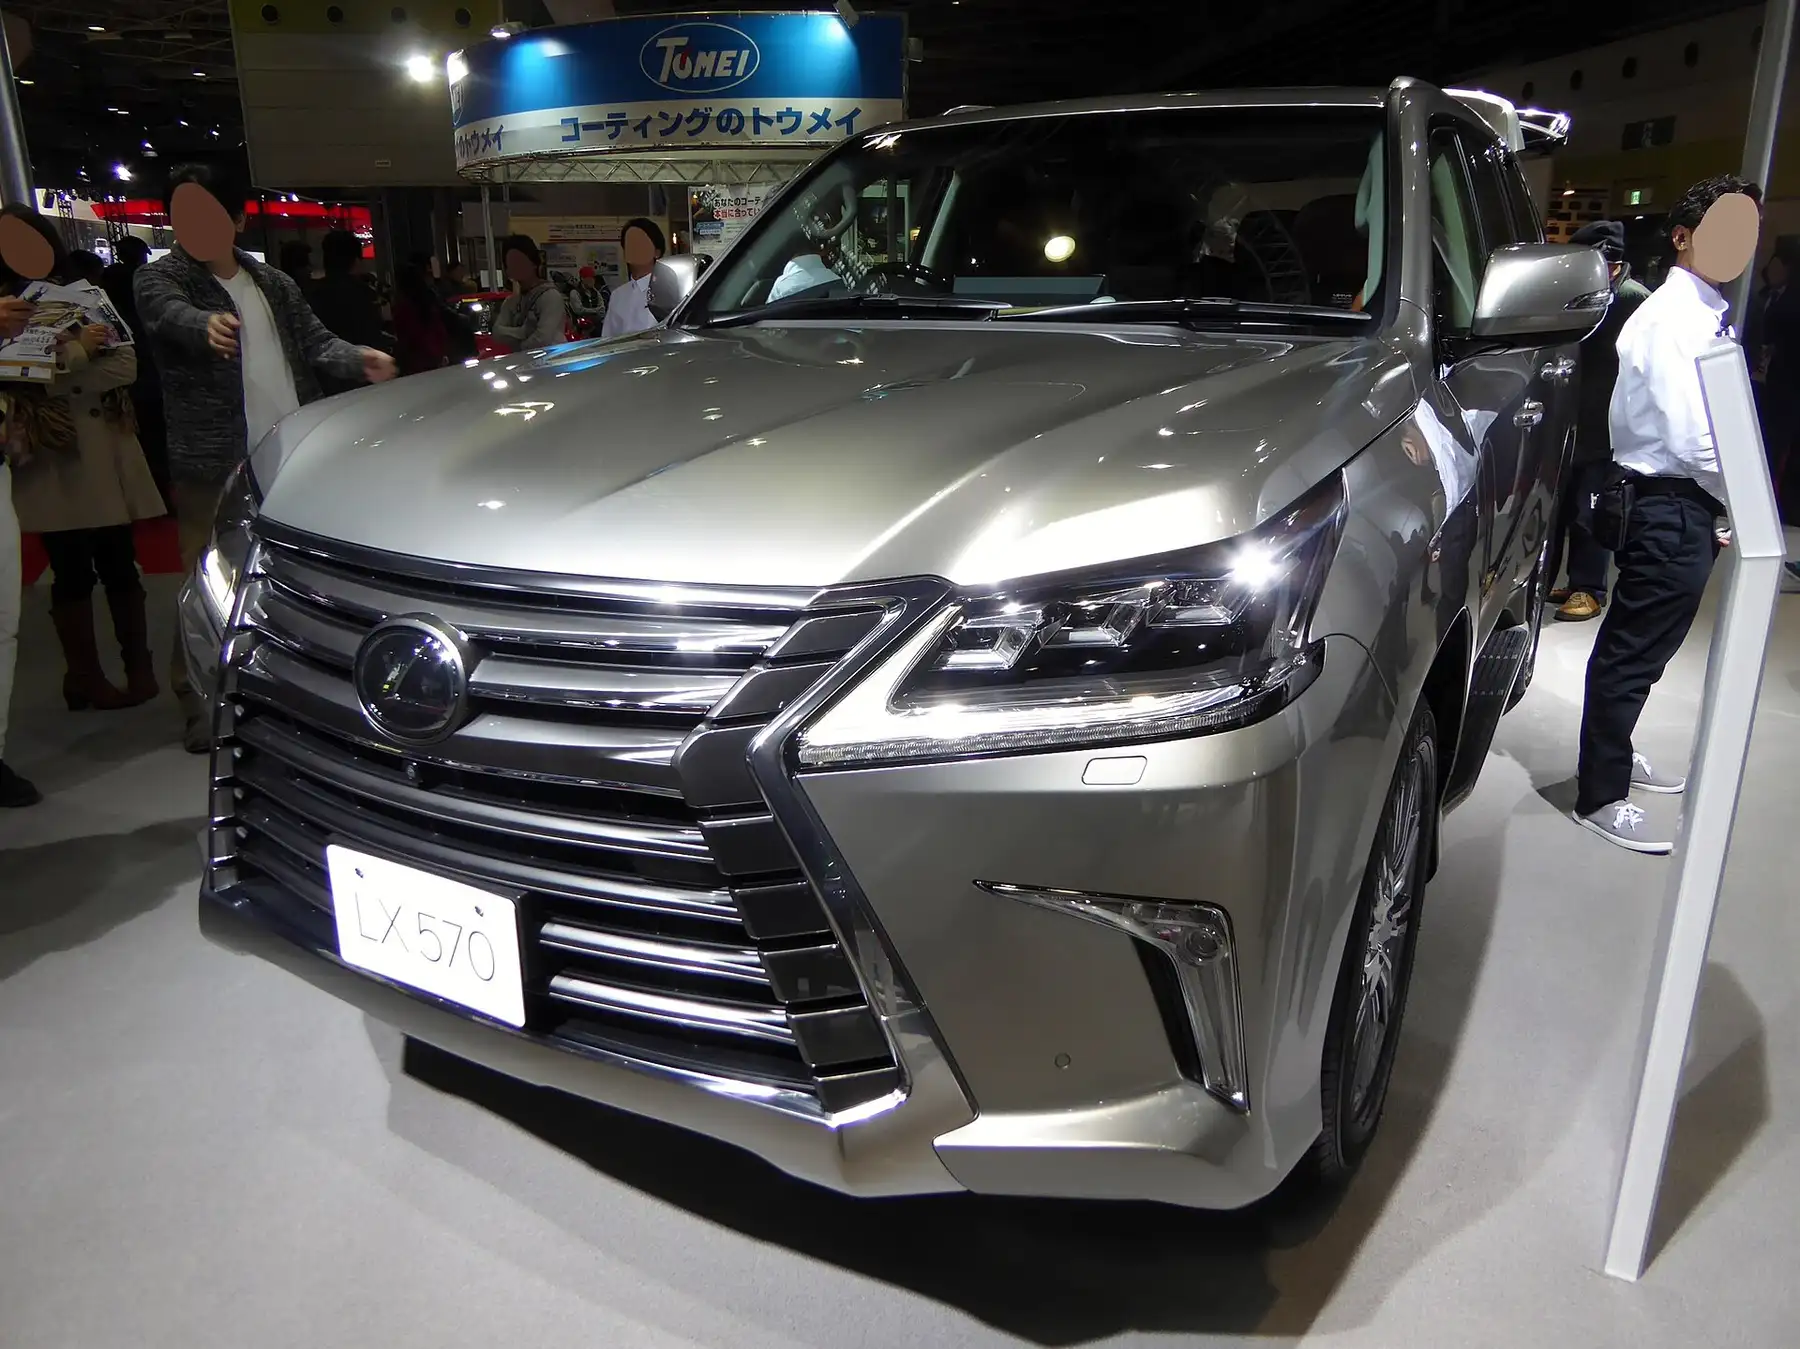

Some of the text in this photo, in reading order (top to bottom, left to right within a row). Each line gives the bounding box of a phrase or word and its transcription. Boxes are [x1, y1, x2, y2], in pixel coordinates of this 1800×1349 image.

[656, 37, 750, 83] TOMEI
[560, 107, 862, 142] コーティングのトウメイ
[355, 891, 496, 982] LX 570
